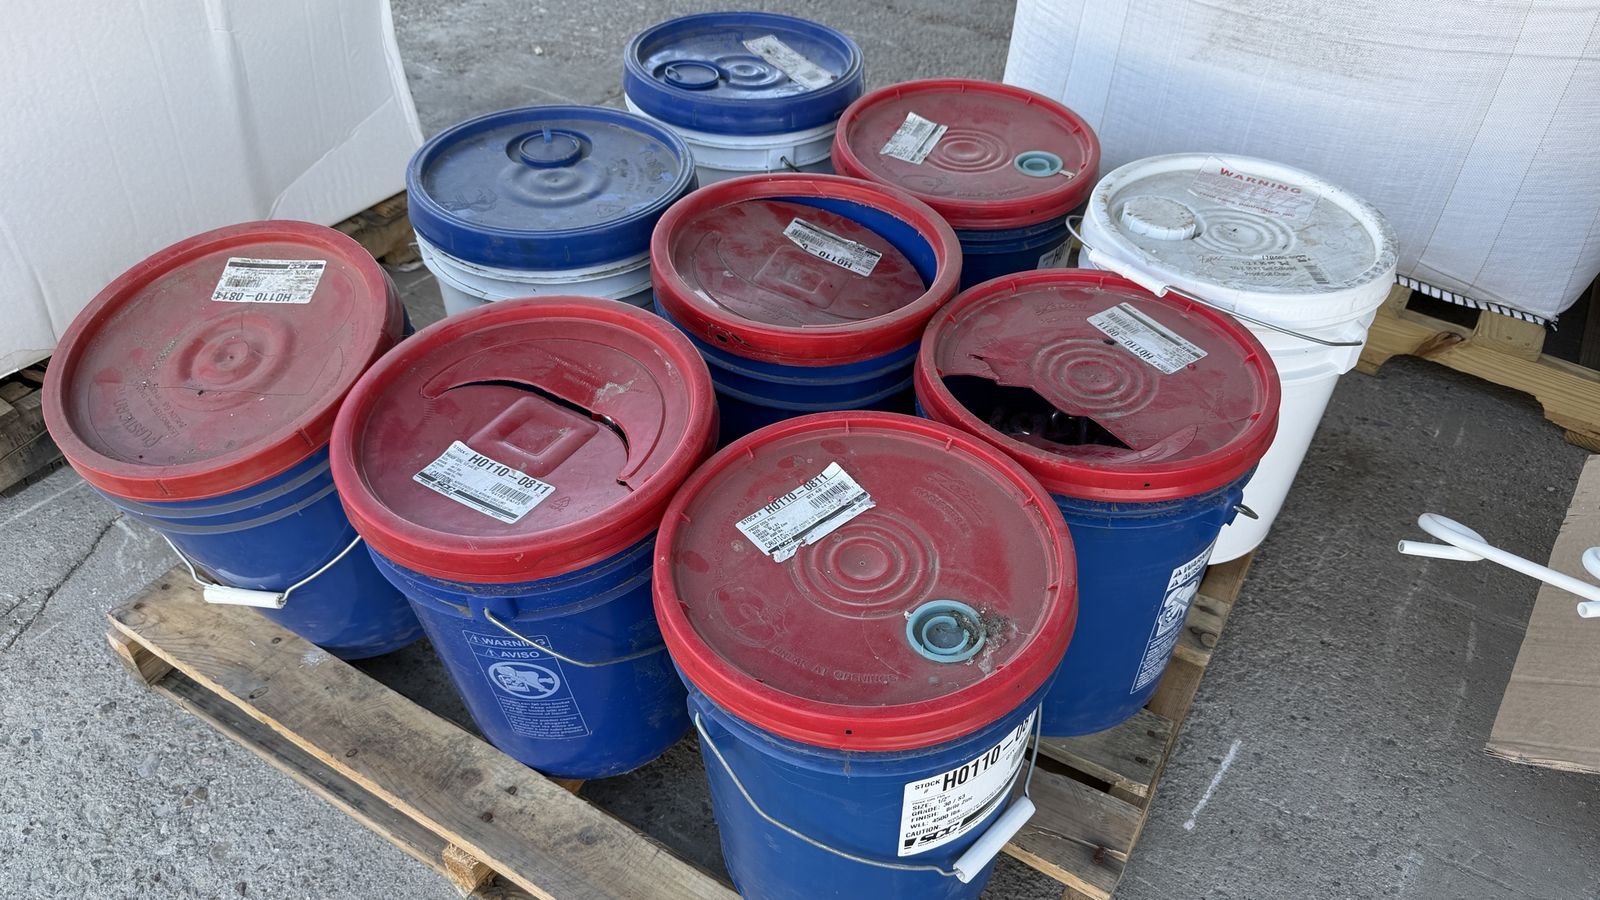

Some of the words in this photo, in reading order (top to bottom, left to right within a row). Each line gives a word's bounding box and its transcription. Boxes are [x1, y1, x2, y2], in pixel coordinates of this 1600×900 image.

[1219, 167, 1302, 194] WARNING
[215, 291, 292, 302] H0110-0811
[1097, 322, 1154, 360] H0110-0811
[468, 453, 551, 495] H0110-0811
[741, 514, 758, 525] STOCK
[764, 473, 829, 514] H0110-0811
[481, 637, 546, 647] WARNIG
[914, 779, 941, 790] STOCK
[912, 803, 932, 811] SIZE:
[912, 806, 940, 817] GRADE:
[911, 811, 939, 822] FINISH:
[932, 814, 949, 823] 4500
[905, 825, 941, 838] CAUTION:
[919, 821, 960, 841] SCC
